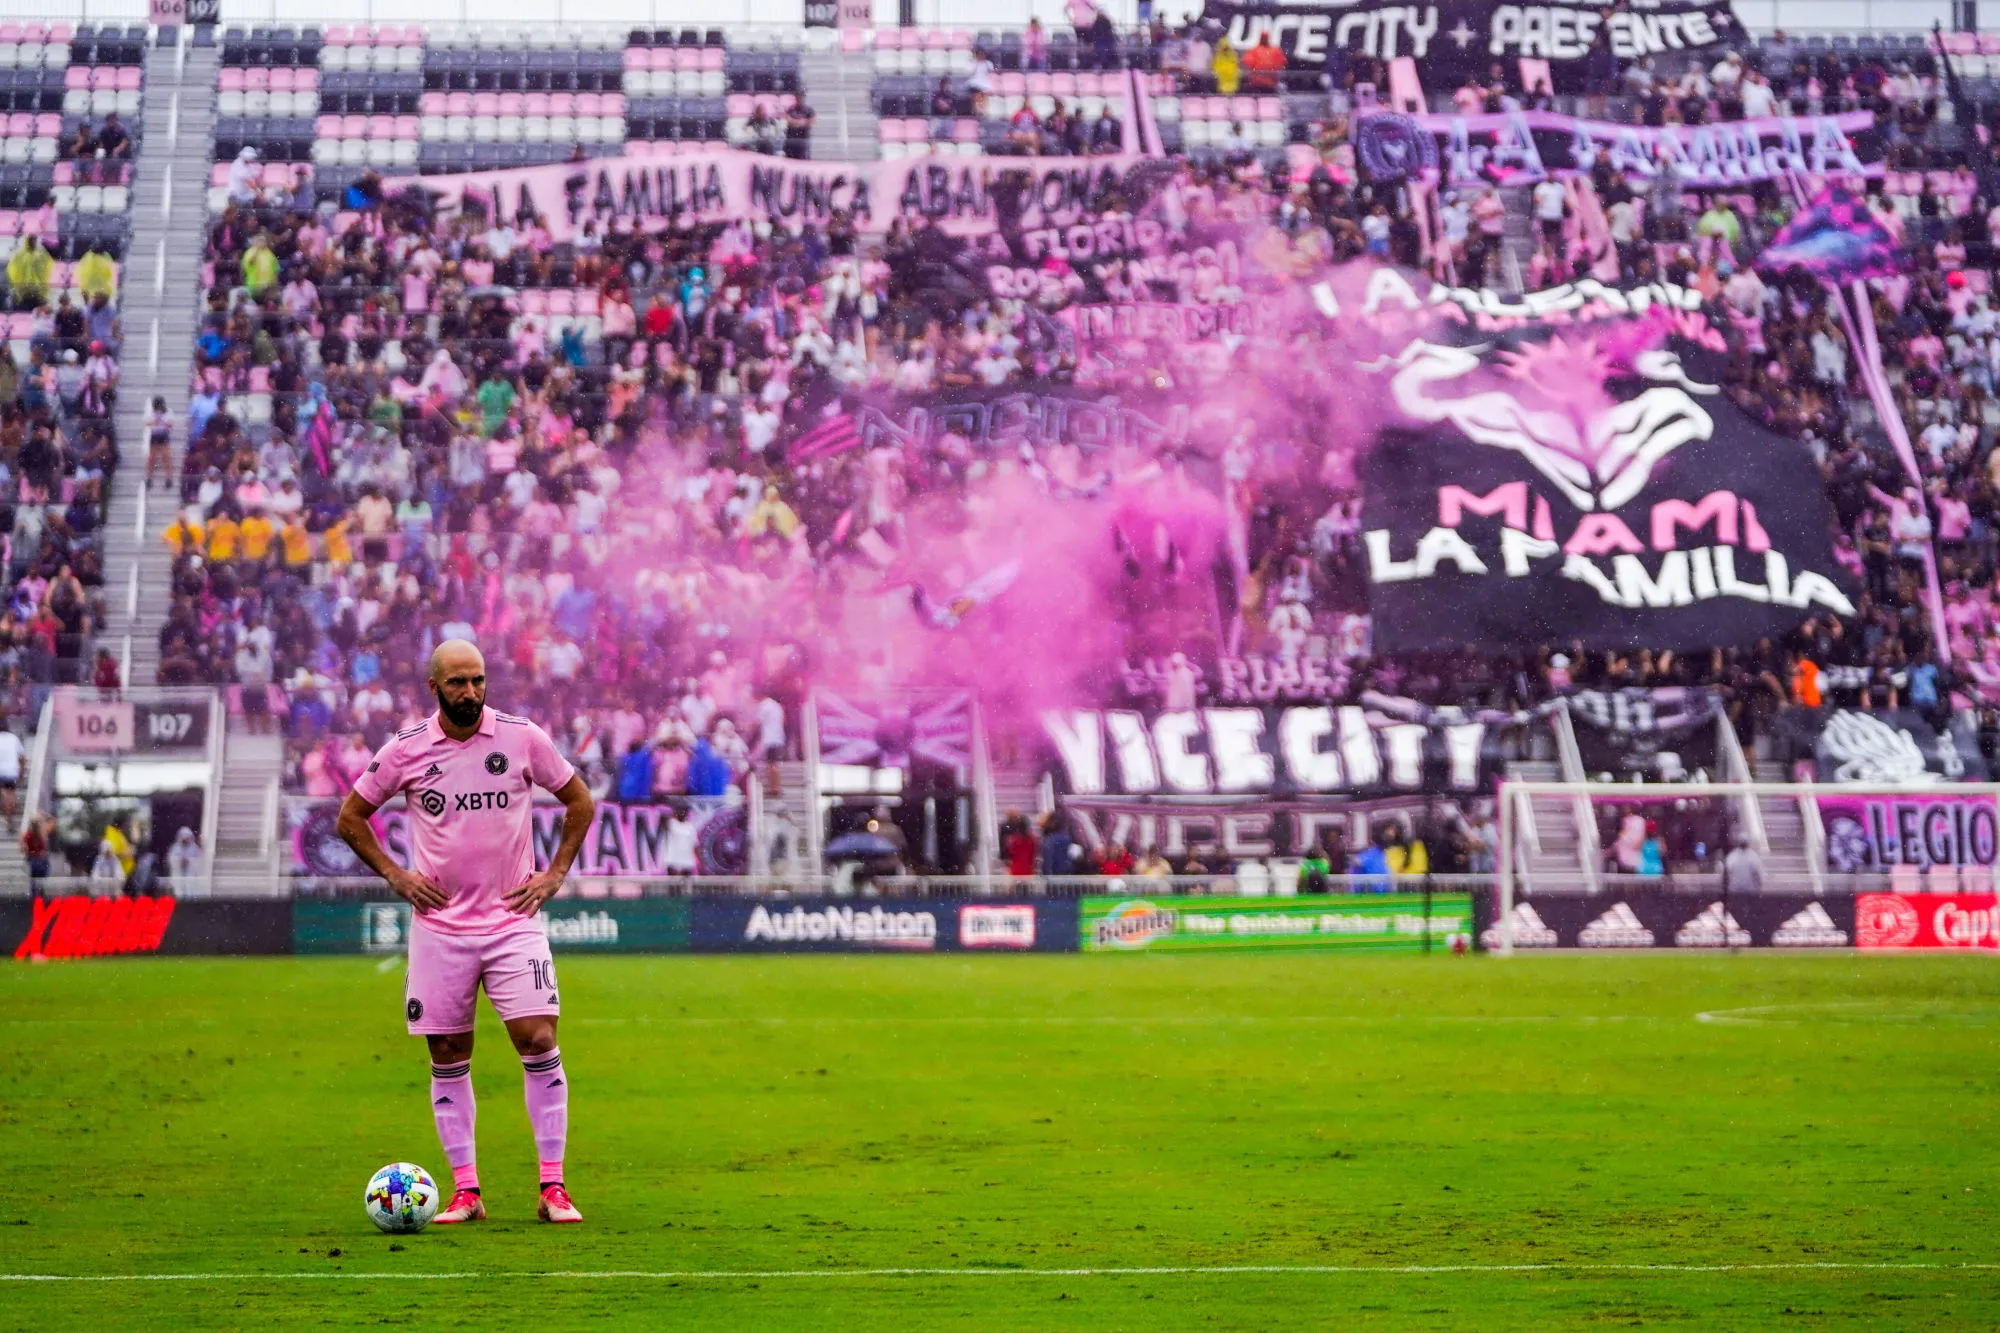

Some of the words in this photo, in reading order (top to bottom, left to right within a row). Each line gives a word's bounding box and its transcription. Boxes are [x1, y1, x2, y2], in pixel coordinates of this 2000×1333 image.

[564, 160, 726, 226] FAMILIA
[749, 162, 873, 220] NUNCA
[901, 162, 1118, 219] ABAONA
[1438, 480, 1771, 555] MIAMI
[1365, 526, 1489, 583] LA
[1500, 526, 1858, 617] FAMILIA
[76, 714, 118, 736] 106
[148, 712, 193, 742] 107
[1044, 706, 1275, 794] VICE
[1279, 706, 1486, 793] CITY
[455, 791, 508, 811] XBTO
[743, 905, 938, 941] AutoNation
[527, 958, 557, 990] 10
